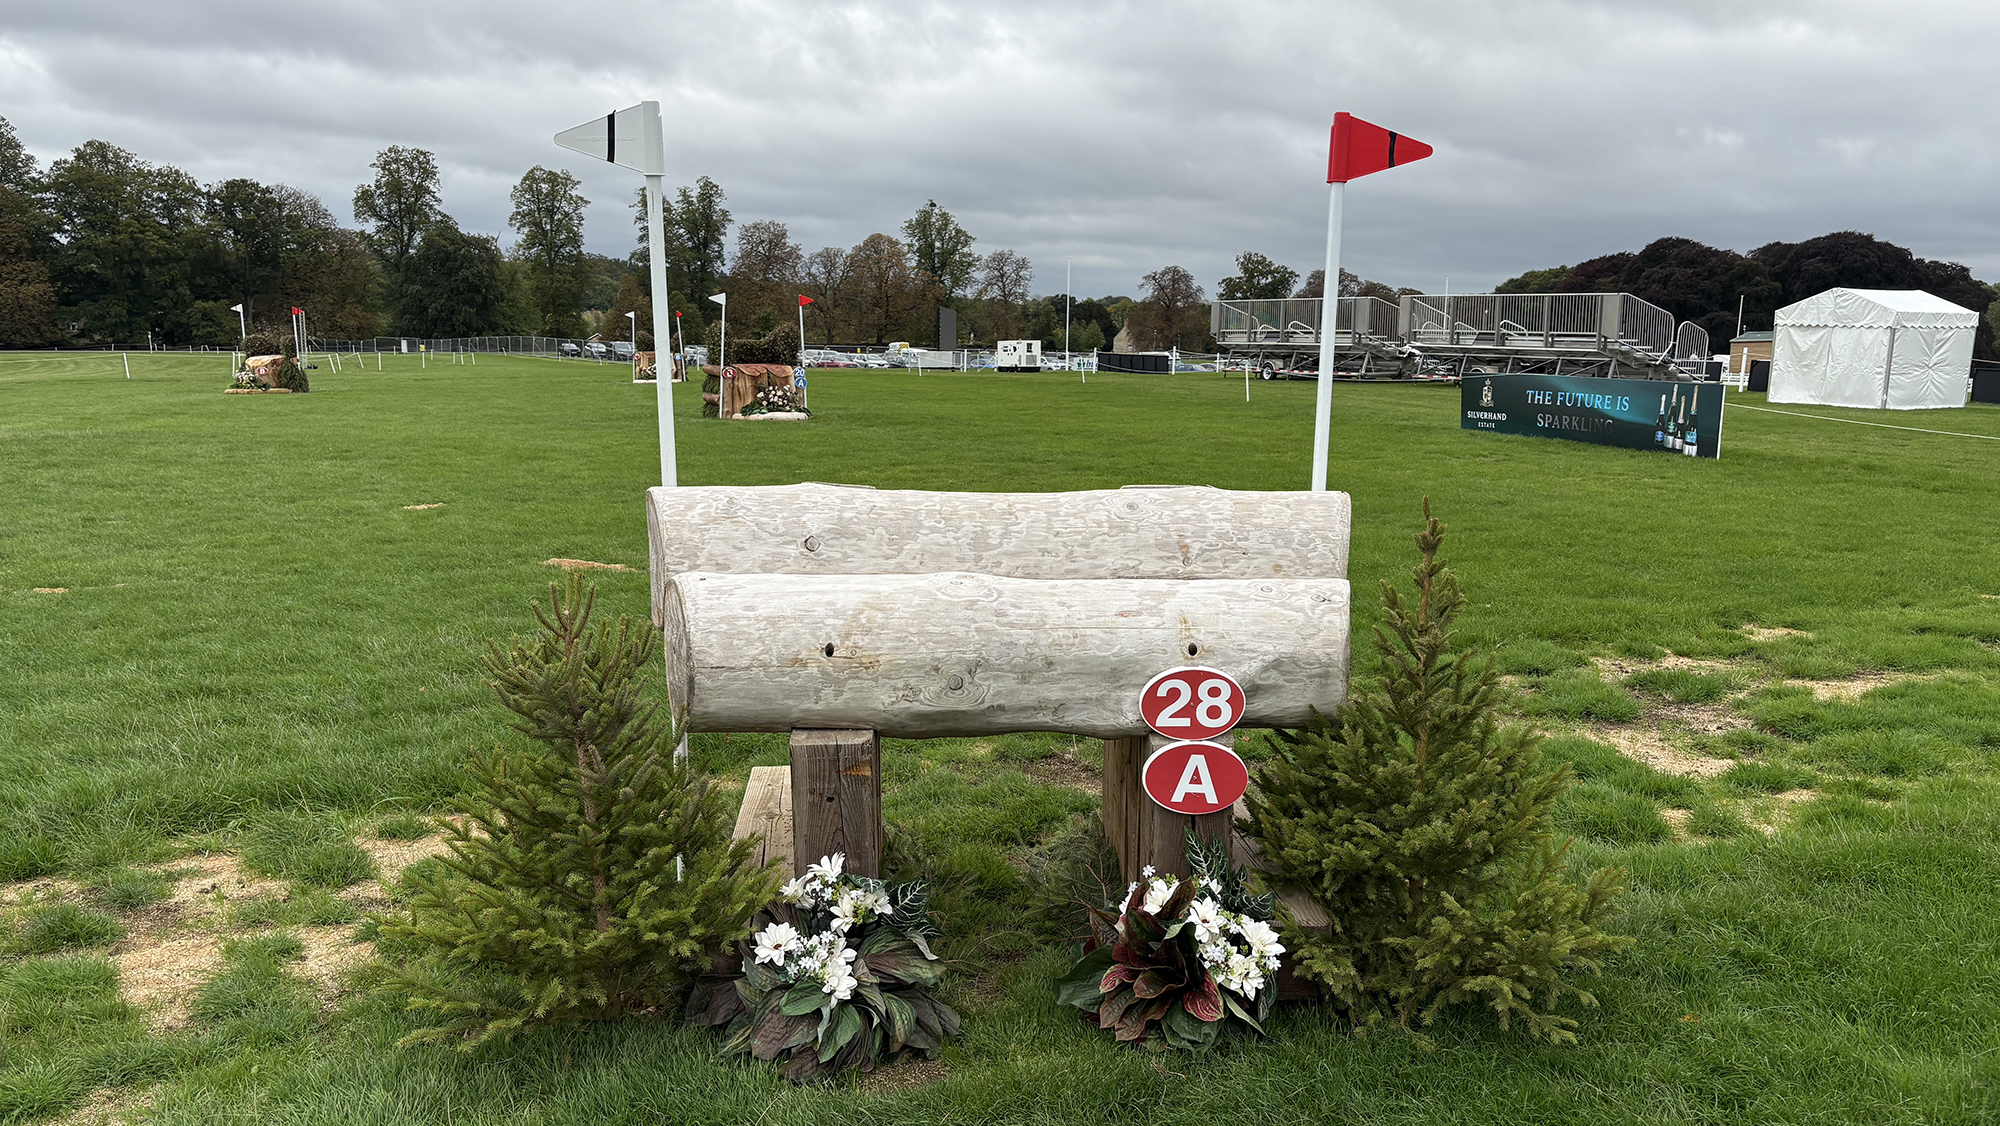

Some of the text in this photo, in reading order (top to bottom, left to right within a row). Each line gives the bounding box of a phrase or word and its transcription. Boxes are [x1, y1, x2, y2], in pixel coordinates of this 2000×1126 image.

[795, 369, 804, 377] 20
[1526, 390, 1630, 411] THE FUTURE IS
[1467, 411, 1507, 421] SILVERHAND
[1478, 421, 1496, 429] ESTATE
[1537, 413, 1613, 434] SPARKLING
[1155, 678, 1233, 728] 28
[1170, 754, 1219, 805] A
